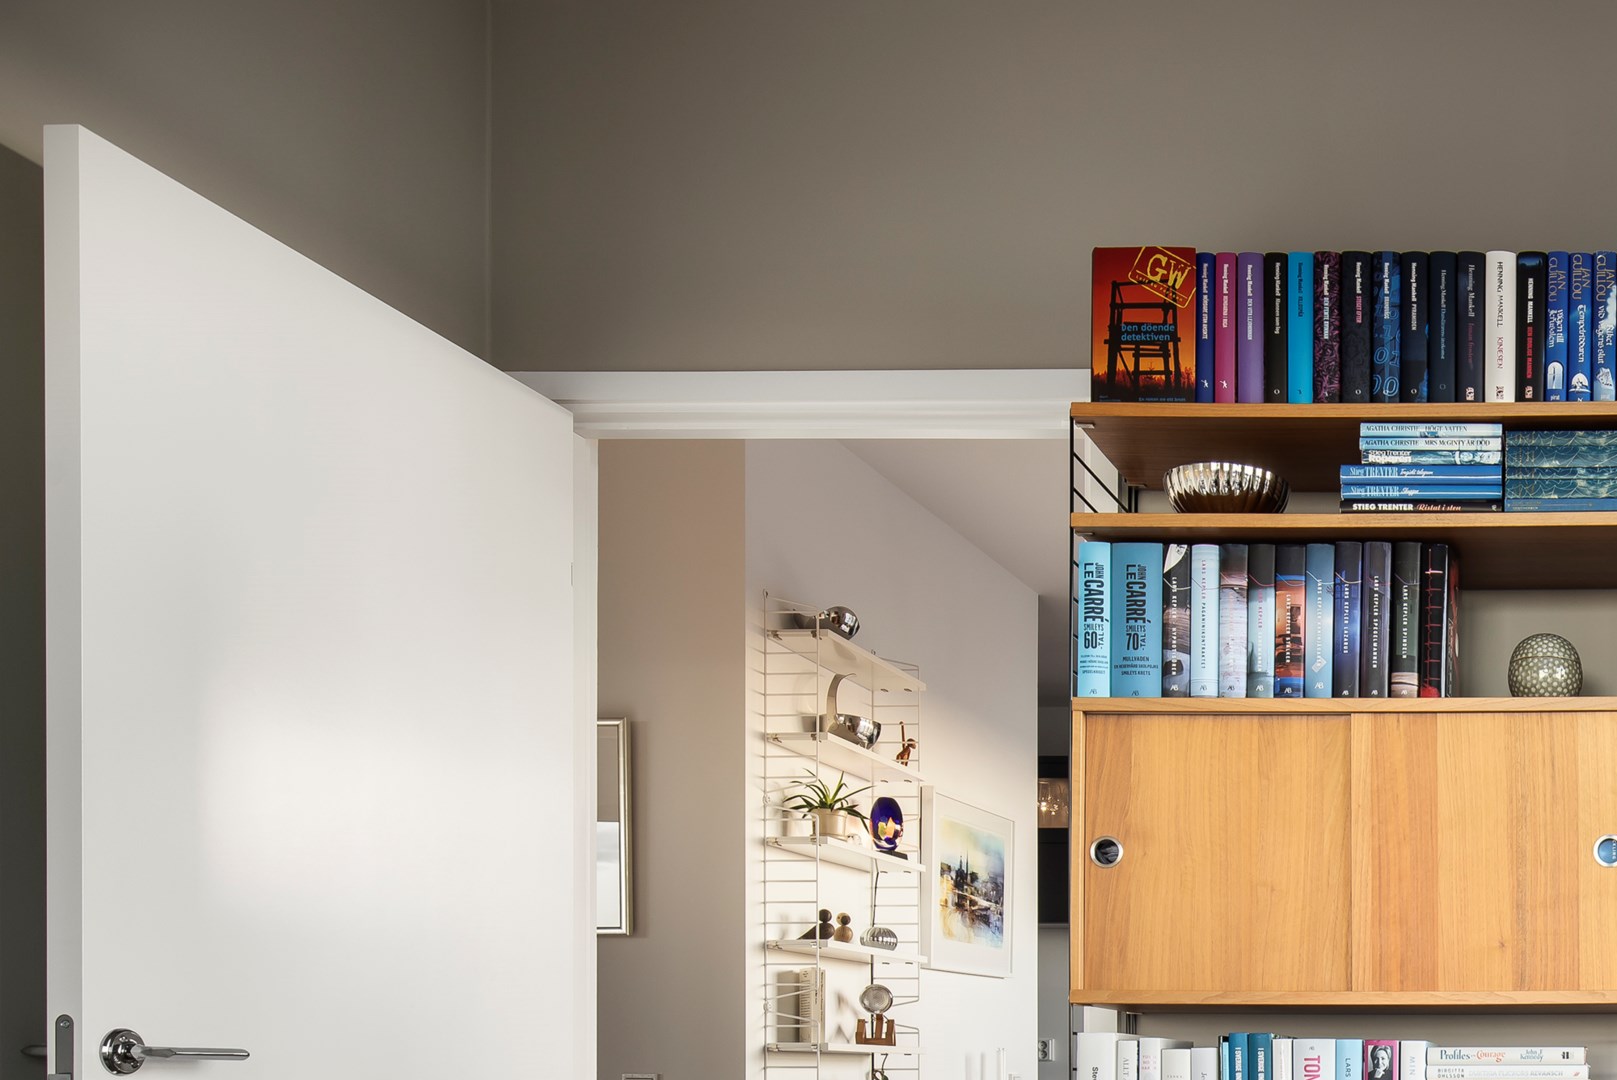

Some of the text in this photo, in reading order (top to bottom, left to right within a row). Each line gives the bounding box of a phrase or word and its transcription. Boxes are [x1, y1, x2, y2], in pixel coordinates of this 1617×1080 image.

[1147, 254, 1191, 289] GW
[1496, 261, 1504, 293] HENNING
[1572, 254, 1582, 300] GUILLOU
[1582, 268, 1591, 288] JAN
[1121, 323, 1175, 332] Den döende
[1121, 333, 1170, 341] detektiven
[1083, 563, 1109, 623] JOHN LE CARRÉ
[1126, 564, 1151, 624] JOHN LE CARRÉ
[1408, 1056, 1416, 1075] MIN
[1440, 1049, 1506, 1063] Profiles Courage
